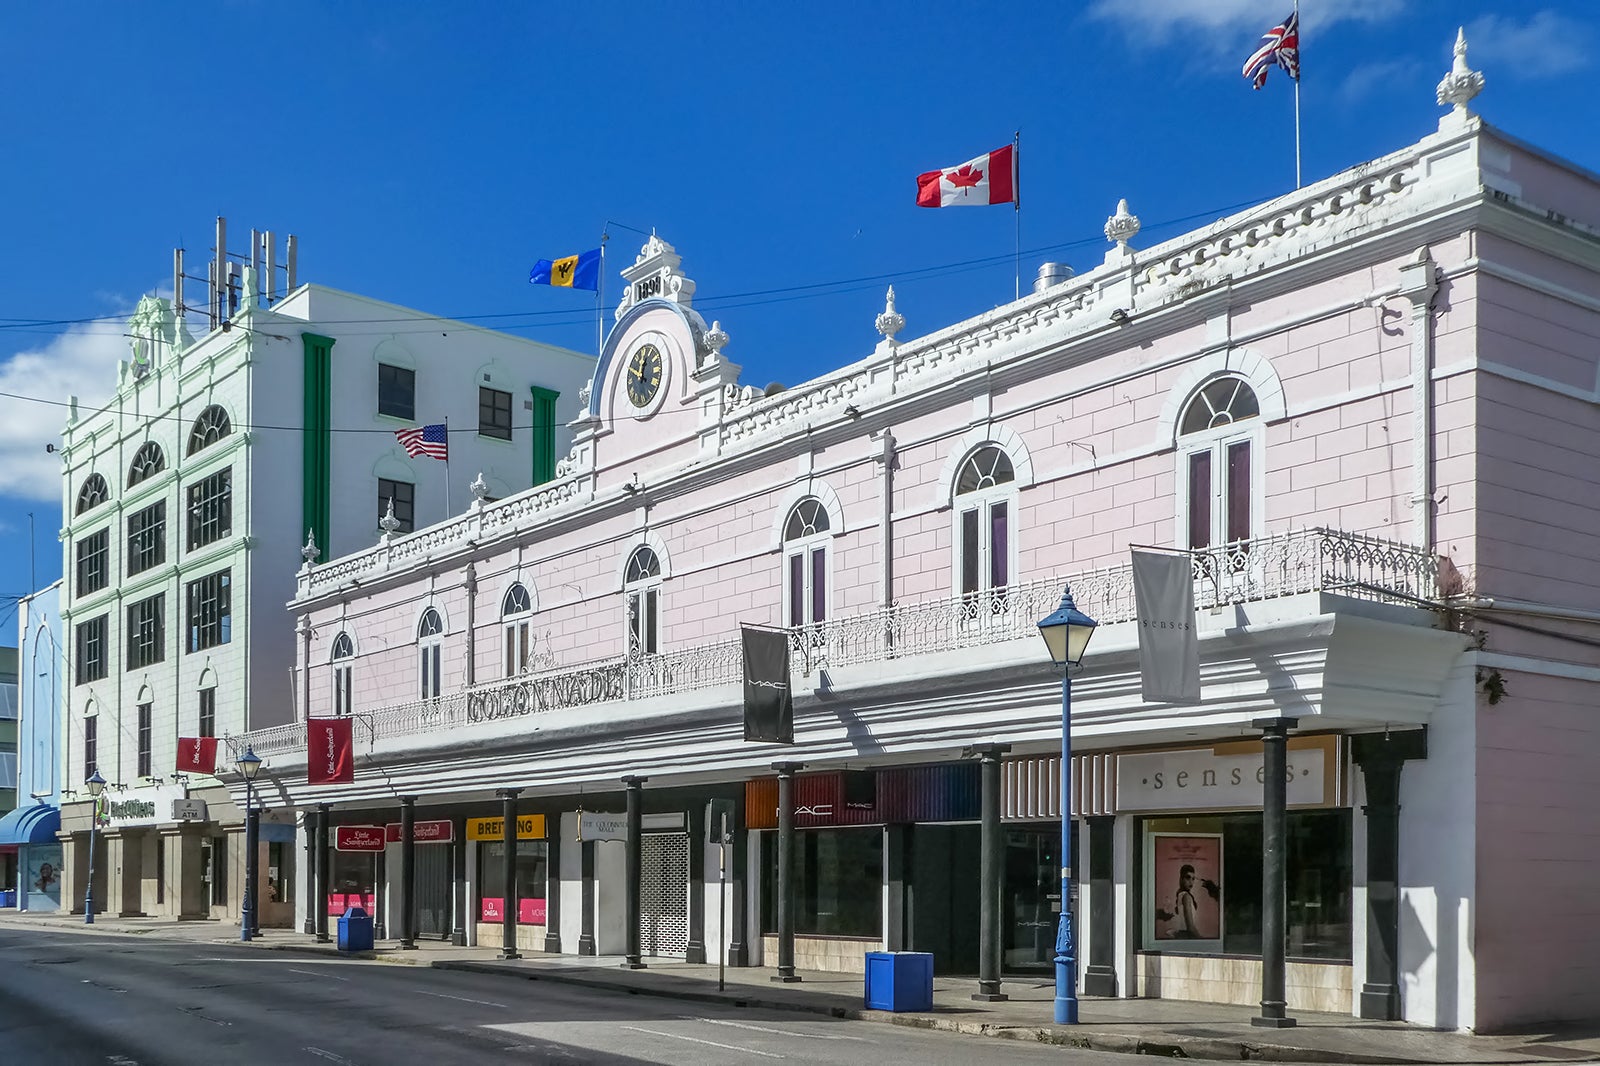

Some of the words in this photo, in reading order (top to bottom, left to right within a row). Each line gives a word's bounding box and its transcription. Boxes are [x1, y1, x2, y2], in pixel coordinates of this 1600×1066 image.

[637, 276, 661, 302] 1898
[1142, 619, 1189, 631] senses
[467, 668, 622, 722] COLONNADE
[478, 820, 533, 835] BREING
